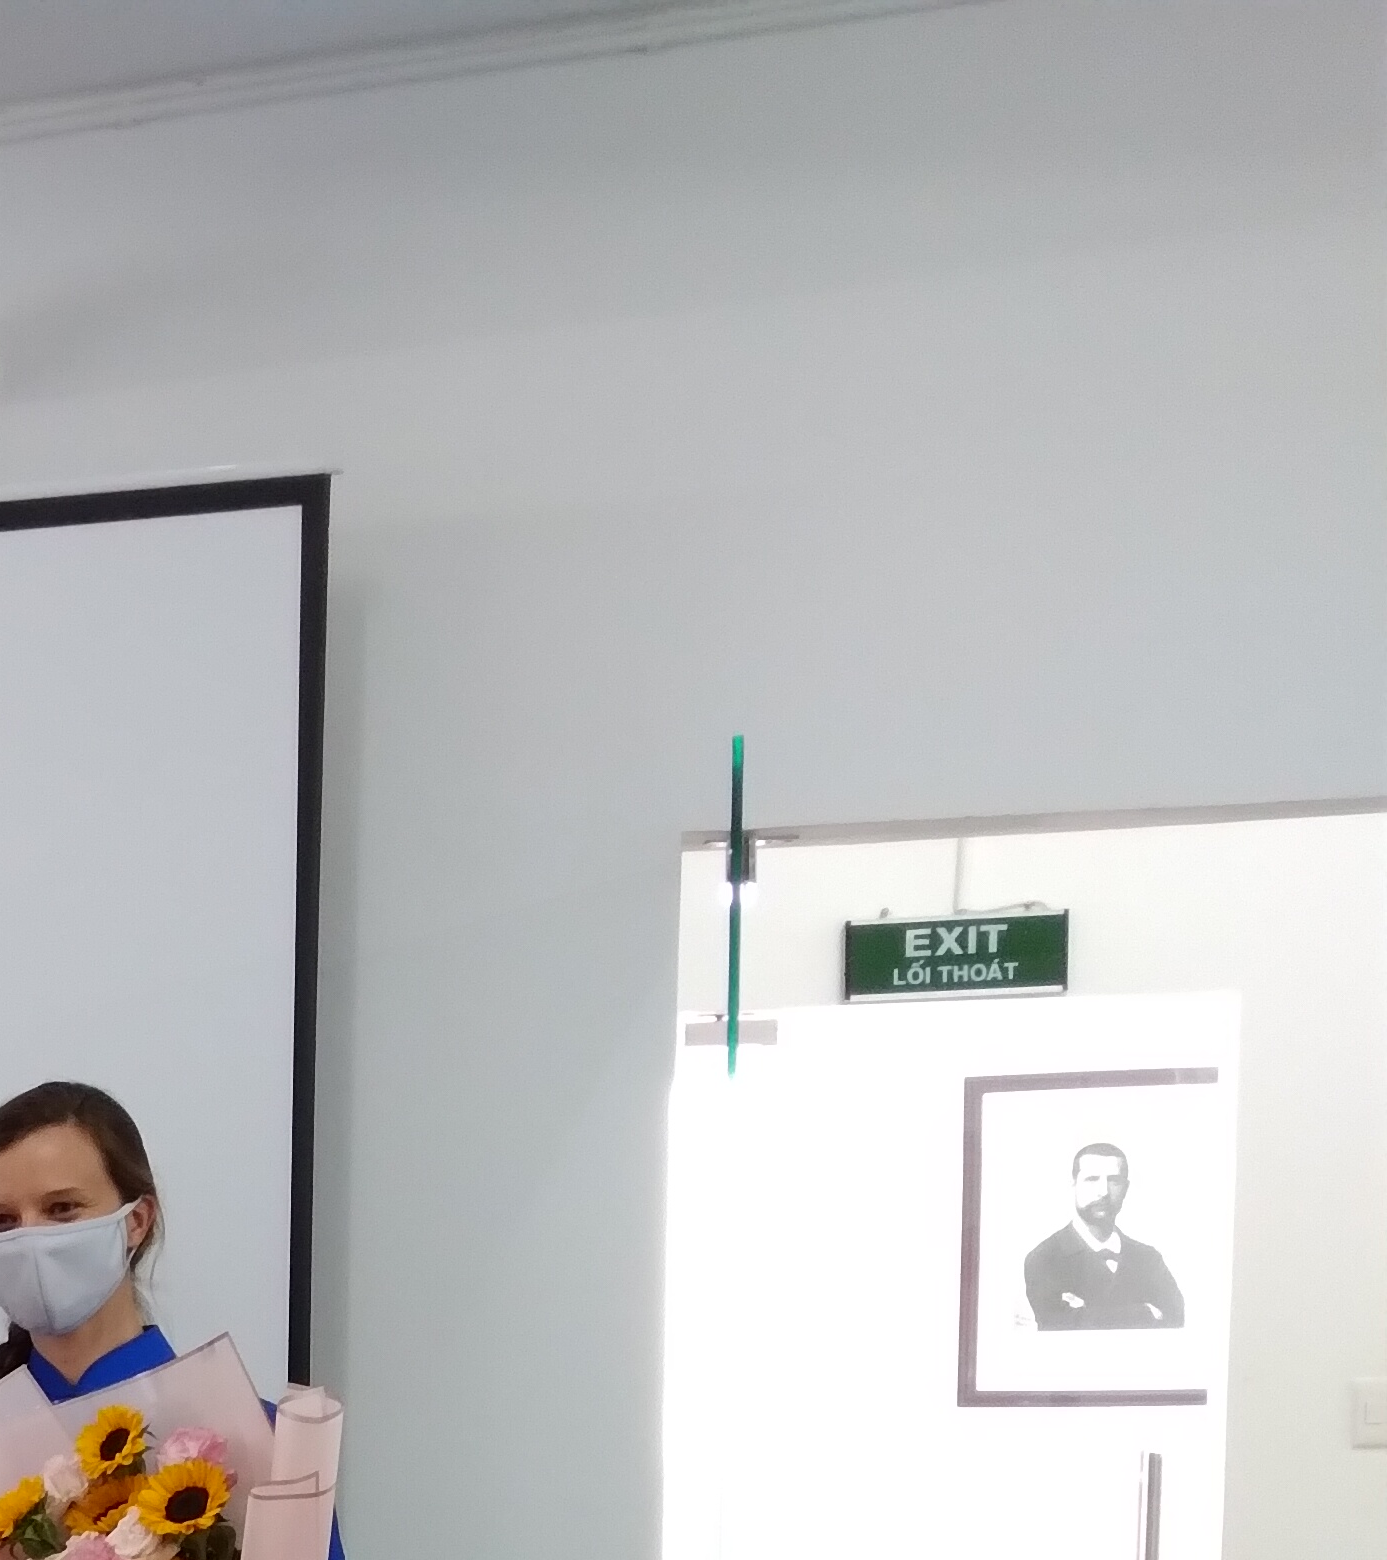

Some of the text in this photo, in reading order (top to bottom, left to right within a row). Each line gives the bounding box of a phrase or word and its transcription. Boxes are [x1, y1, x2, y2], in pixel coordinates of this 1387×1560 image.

[905, 924, 1008, 957] EXIT
[893, 959, 1019, 985] LỐI THOÁT
